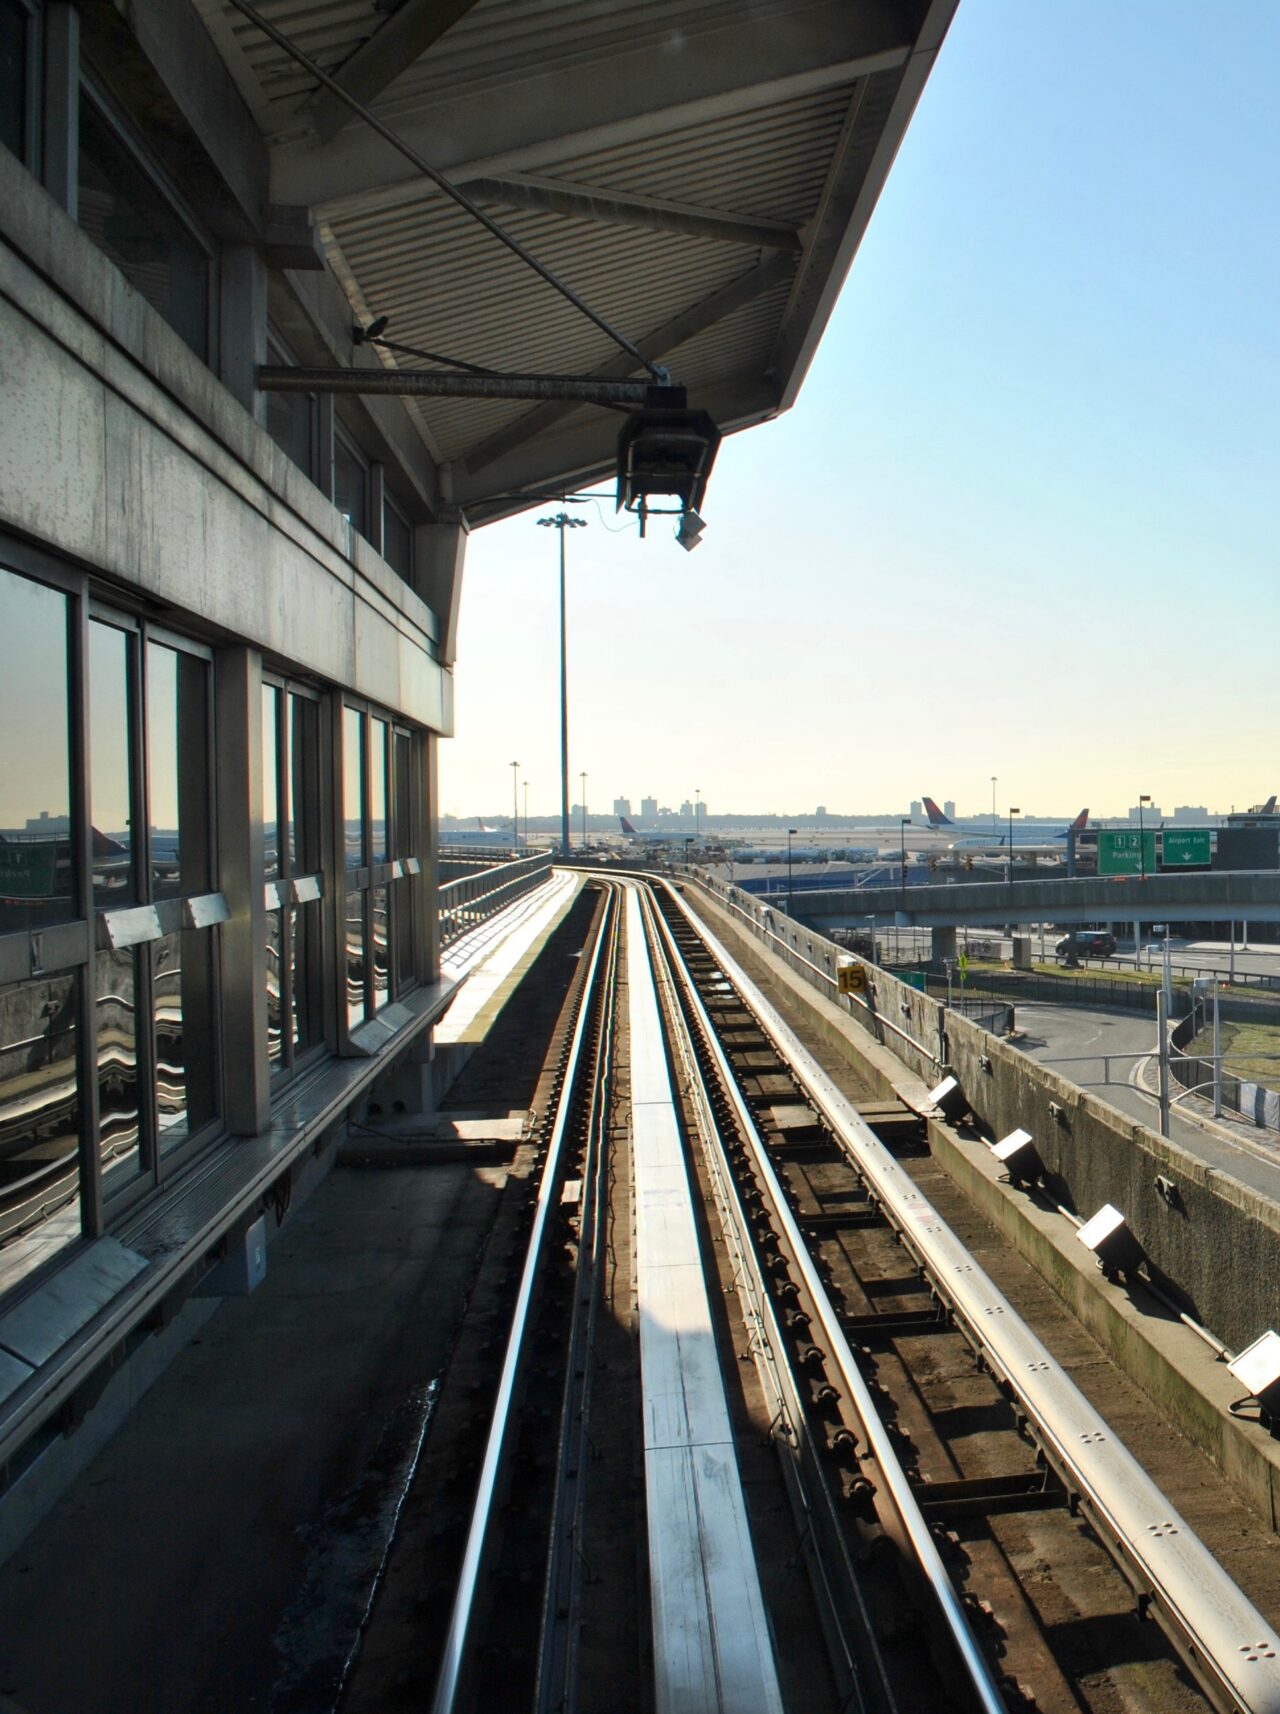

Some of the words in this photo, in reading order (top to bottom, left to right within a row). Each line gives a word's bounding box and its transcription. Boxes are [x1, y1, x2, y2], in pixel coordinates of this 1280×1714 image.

[1117, 838, 1122, 847] 1
[1132, 838, 1138, 847] 2
[1168, 837, 1191, 845] Airport
[1112, 851, 1142, 860] Parking
[839, 971, 862, 989] 15
